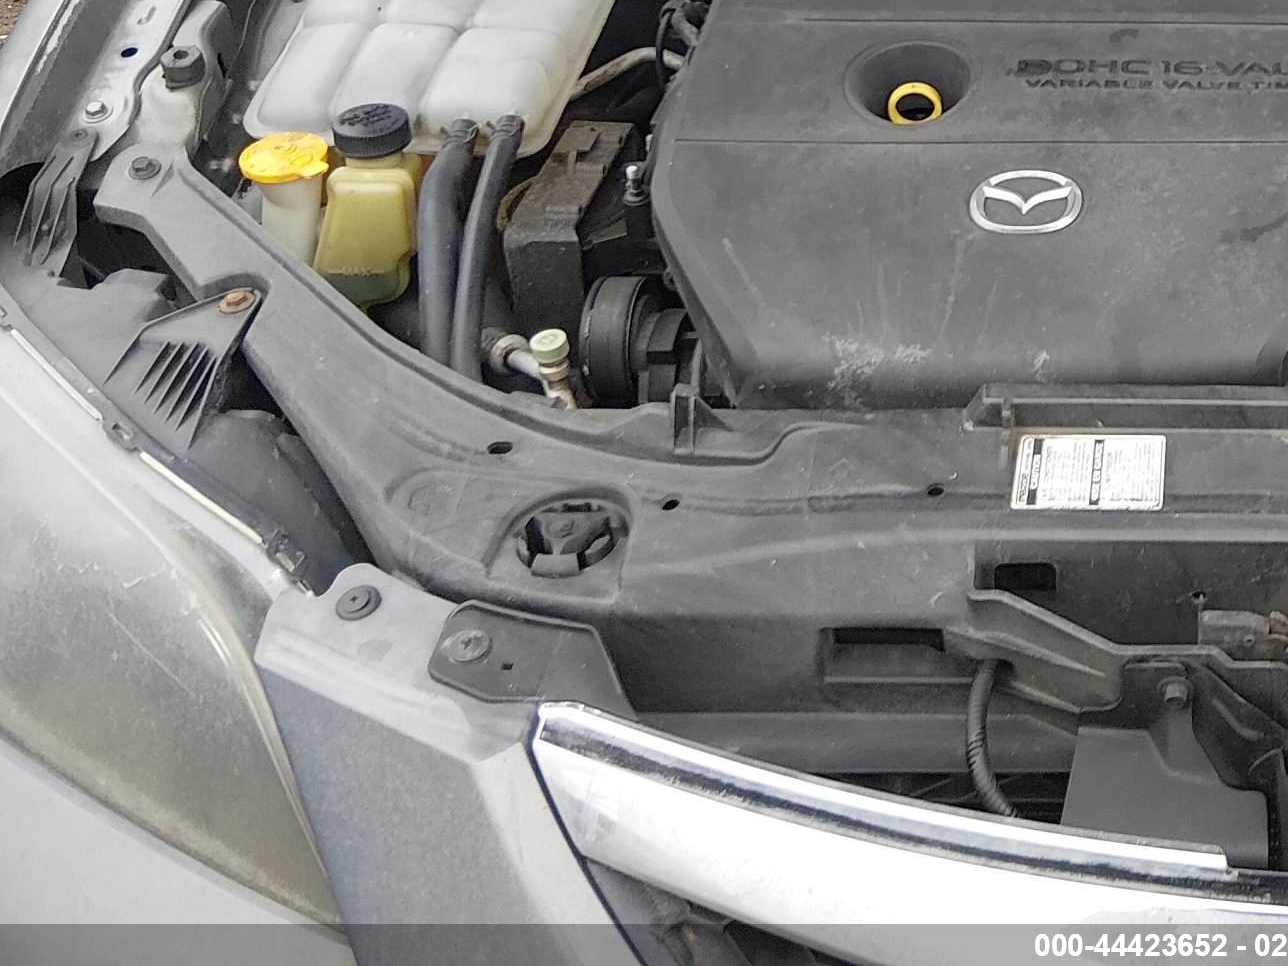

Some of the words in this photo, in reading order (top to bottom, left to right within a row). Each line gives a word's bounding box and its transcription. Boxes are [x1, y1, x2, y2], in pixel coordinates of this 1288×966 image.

[1016, 59, 1150, 76] DOHC
[1025, 79, 1154, 90] VARIABLE
[1163, 80, 1242, 91] VALVE
